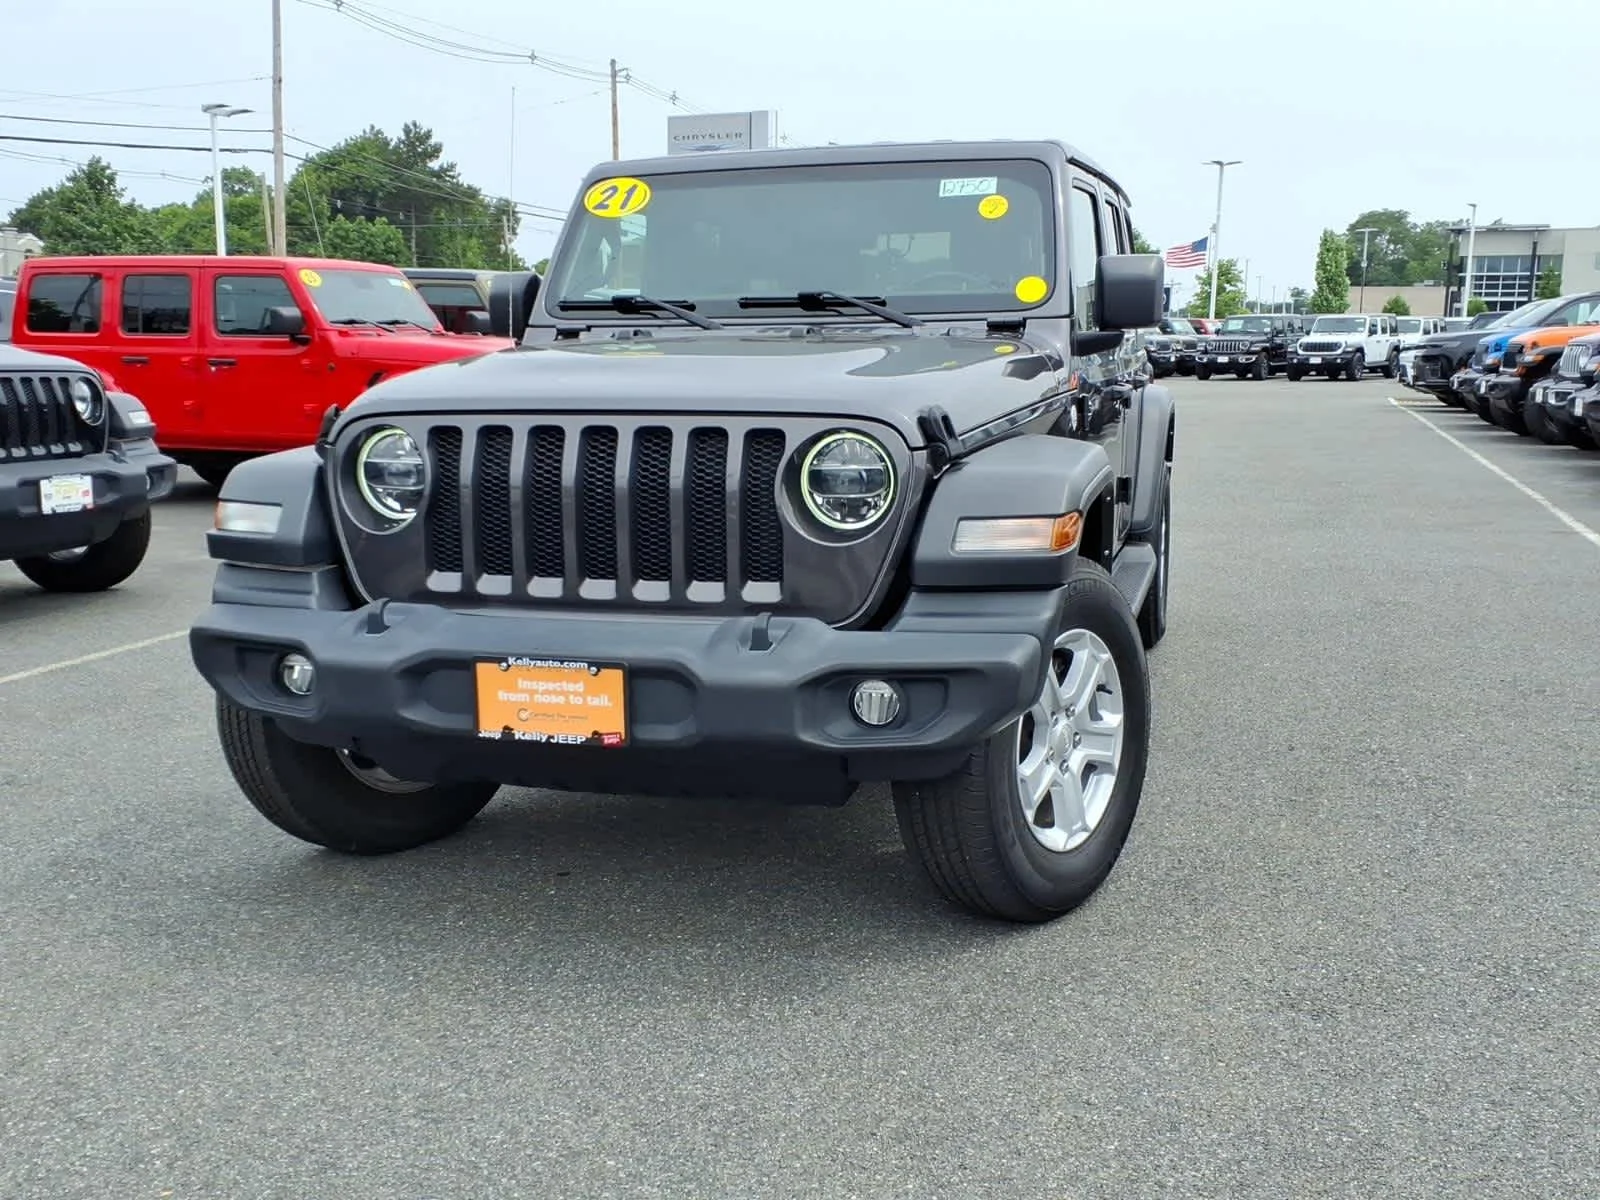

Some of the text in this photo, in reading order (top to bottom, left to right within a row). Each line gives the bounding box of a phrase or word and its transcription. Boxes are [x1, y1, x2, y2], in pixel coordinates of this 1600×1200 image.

[673, 132, 743, 141] CHRYSLER
[592, 183, 639, 210] 21
[508, 656, 588, 669] Kellyauto.com
[517, 678, 584, 693] Inspected
[498, 690, 612, 707] from nose to tail.
[478, 729, 501, 740] Jeep
[513, 730, 549, 743] Kelly
[550, 734, 587, 745] JEEP
